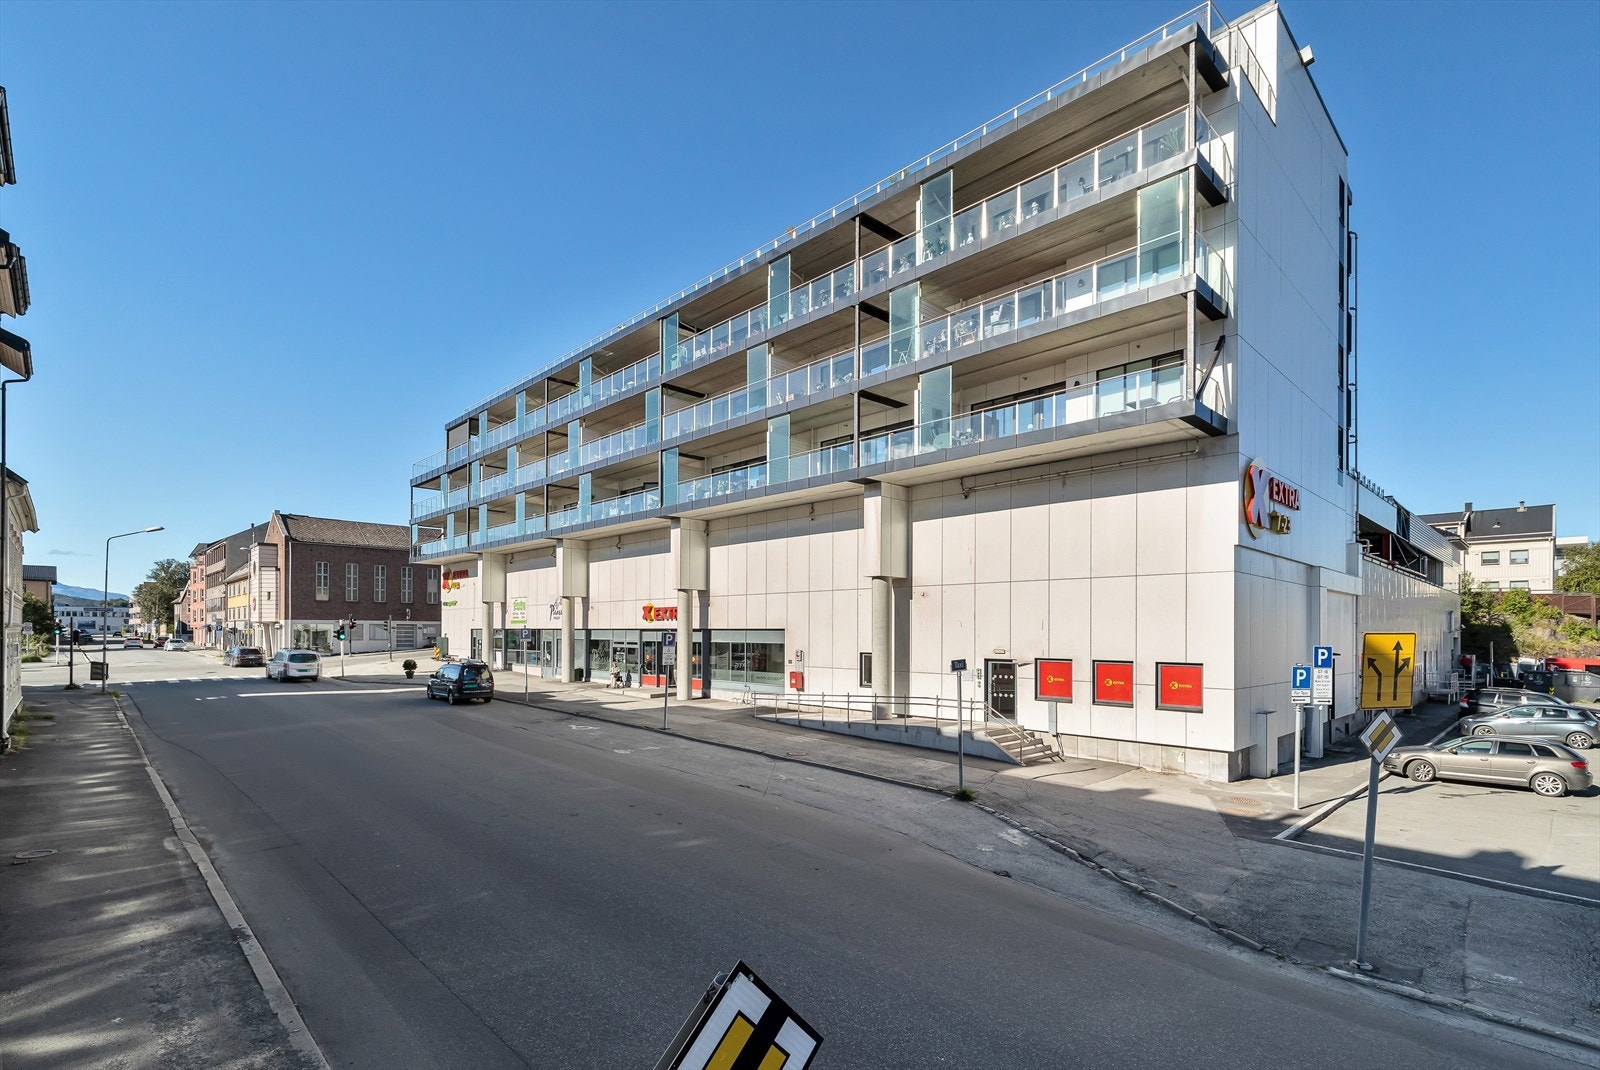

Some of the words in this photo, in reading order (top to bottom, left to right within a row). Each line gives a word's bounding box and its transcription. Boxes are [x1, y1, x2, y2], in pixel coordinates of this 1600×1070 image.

[1270, 477, 1302, 511] EXTRA
[522, 629, 529, 638] P
[665, 634, 673, 645] P
[1317, 648, 1329, 666] P
[1296, 669, 1307, 687] P
